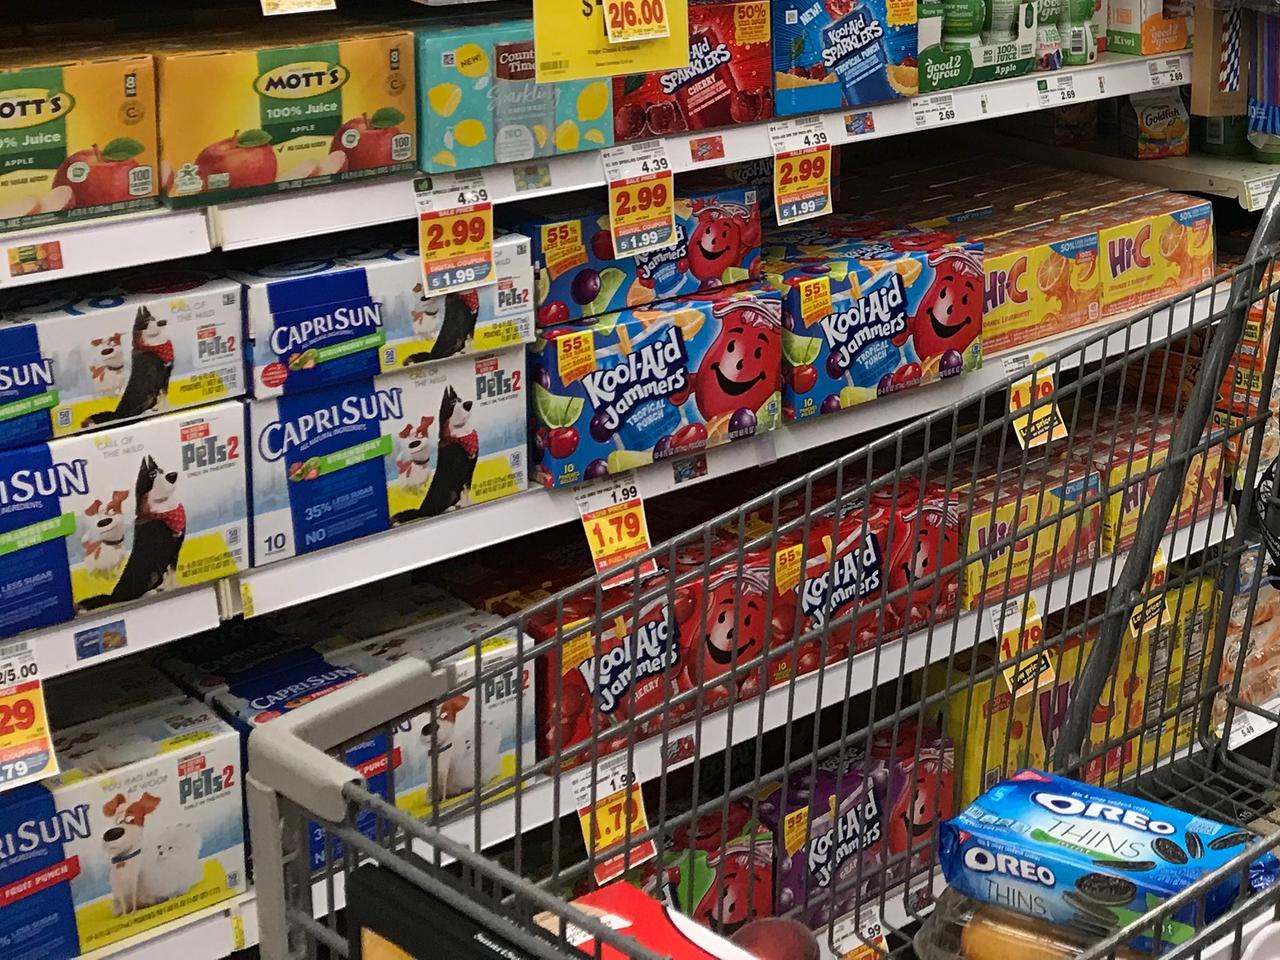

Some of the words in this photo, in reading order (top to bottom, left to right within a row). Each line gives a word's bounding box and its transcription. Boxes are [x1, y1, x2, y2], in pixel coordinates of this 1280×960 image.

[608, 0, 664, 31] 2/6.00
[738, 4, 767, 20] 50%
[800, 2, 822, 26] NEW!
[821, 21, 883, 67] SPARKLERS
[995, 63, 1017, 74] Apple
[1169, 72, 1183, 81] 2.69
[264, 67, 340, 92] MOTT'S
[688, 73, 716, 93] CHERRY
[1060, 90, 1075, 100] 2.69
[266, 105, 303, 120] 100%
[304, 101, 338, 116] Juice
[938, 110, 955, 121] 2.69
[1145, 107, 1181, 127] Goldfish
[21, 130, 61, 147] Juice
[290, 123, 316, 134] APPLE
[803, 131, 828, 146] 4.39
[3, 155, 35, 168] APPLE
[640, 156, 669, 174] 4.39
[780, 156, 826, 186] 2.99
[615, 184, 667, 217] 2.99
[791, 200, 816, 216] 1.99
[427, 217, 486, 251] 2.99
[630, 232, 659, 248] 1.99
[642, 244, 687, 278] Jammers
[443, 268, 475, 286] 1.99
[838, 314, 906, 367] Jammers
[856, 340, 889, 365] TROPICAL
[864, 348, 888, 369] PUNCH
[604, 367, 685, 430] Jammers
[626, 399, 666, 424] TROPICAL
[637, 410, 664, 431] PUNCH
[609, 485, 639, 503] 1.99
[304, 528, 326, 546] NO
[592, 511, 642, 549] 1.79
[264, 532, 286, 551] 10
[1032, 792, 1175, 836] OREO
[1048, 819, 1145, 859] THINS
[964, 847, 1057, 886] OREO
[5, 881, 32, 898] FRUIT
[34, 865, 69, 882] PUNCH
[984, 879, 1048, 916] THINS
